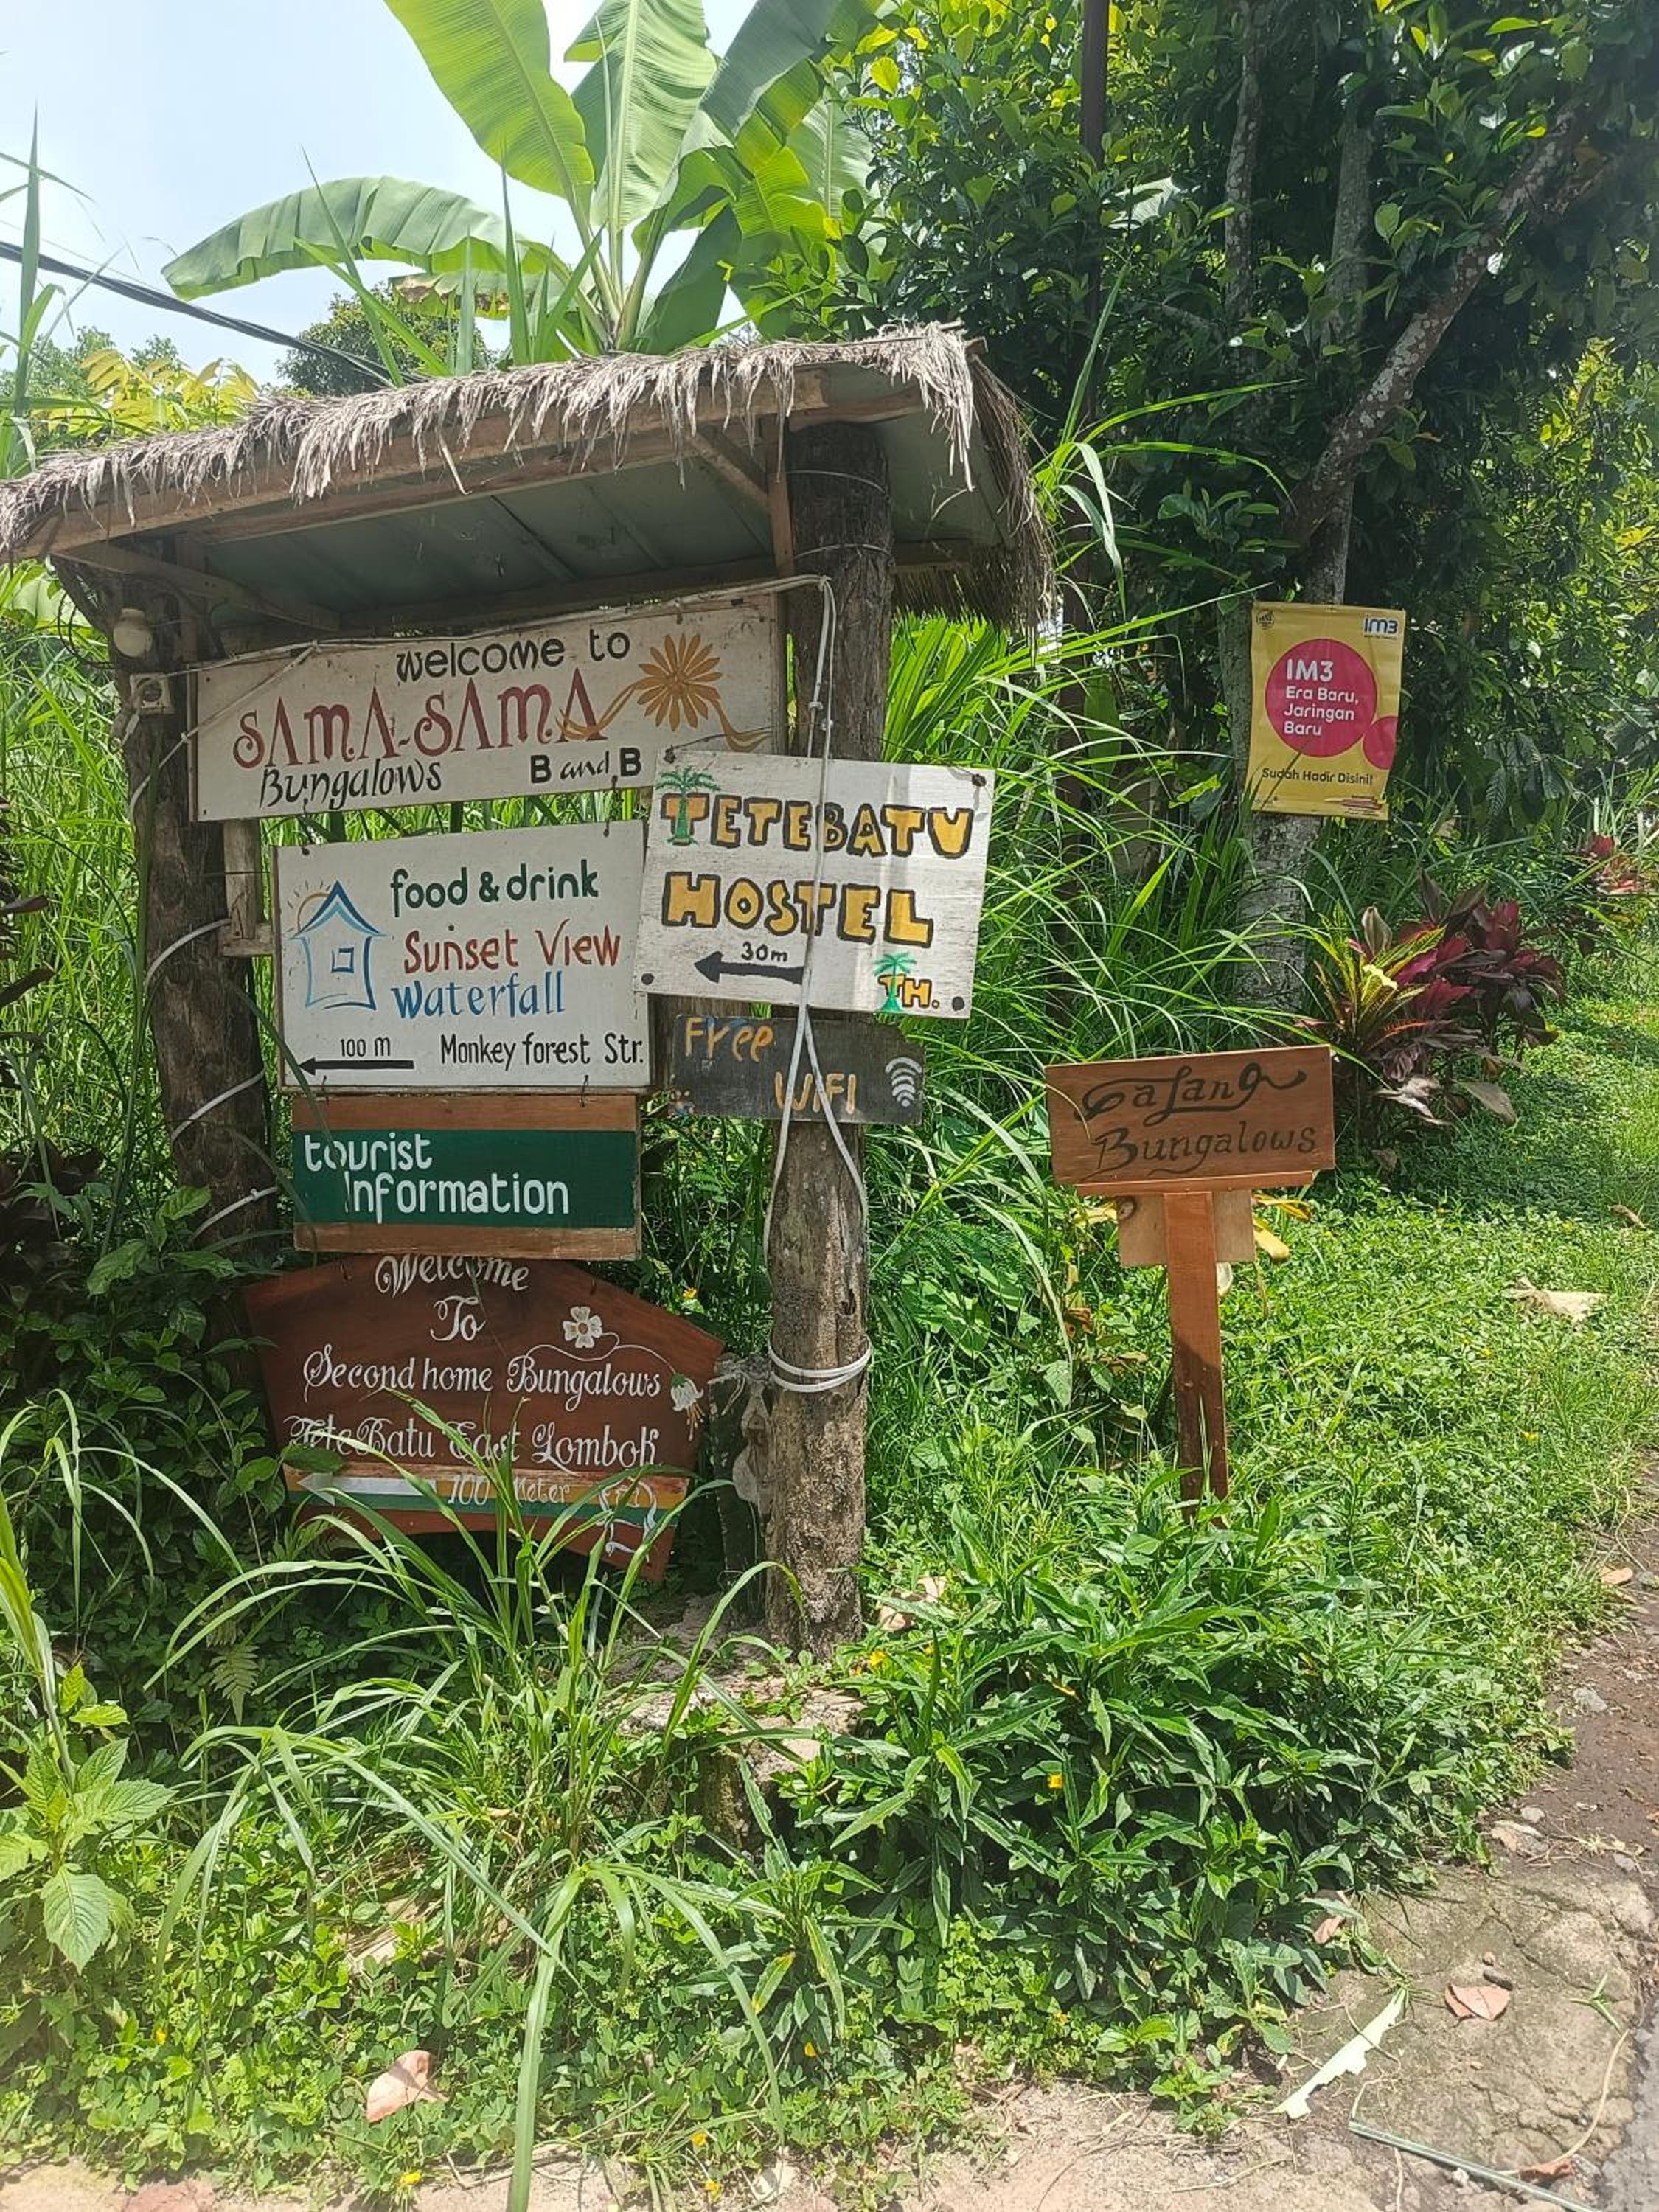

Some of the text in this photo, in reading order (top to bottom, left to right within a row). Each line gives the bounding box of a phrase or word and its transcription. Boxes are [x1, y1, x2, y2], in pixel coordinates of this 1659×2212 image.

[397, 628, 630, 683] welcome to
[1286, 658, 1334, 681] IM3
[1284, 703, 1355, 723] Jaringan
[1285, 685, 1359, 705] Era Baru,
[1284, 721, 1322, 737] Baru
[260, 747, 642, 810] Bungalows B and B
[1262, 767, 1374, 785] Sudah Hadir Disini!
[661, 792, 974, 860] TETEBATU
[390, 859, 599, 918] food & drink
[662, 871, 934, 949] HOSTEL
[404, 928, 518, 975] Sunset
[341, 1038, 367, 1058] 100
[441, 1033, 517, 1071] Monkey
[521, 1033, 591, 1065] forest
[604, 1032, 644, 1065] Str.
[684, 1017, 773, 1062] Free
[304, 1132, 433, 1172] tourist
[1081, 1121, 1316, 1183] Bungalows
[375, 1254, 529, 1298] Welcome
[430, 1295, 487, 1342] To
[302, 1345, 661, 1412] Second home Bungalows
[448, 1474, 492, 1506] 100
